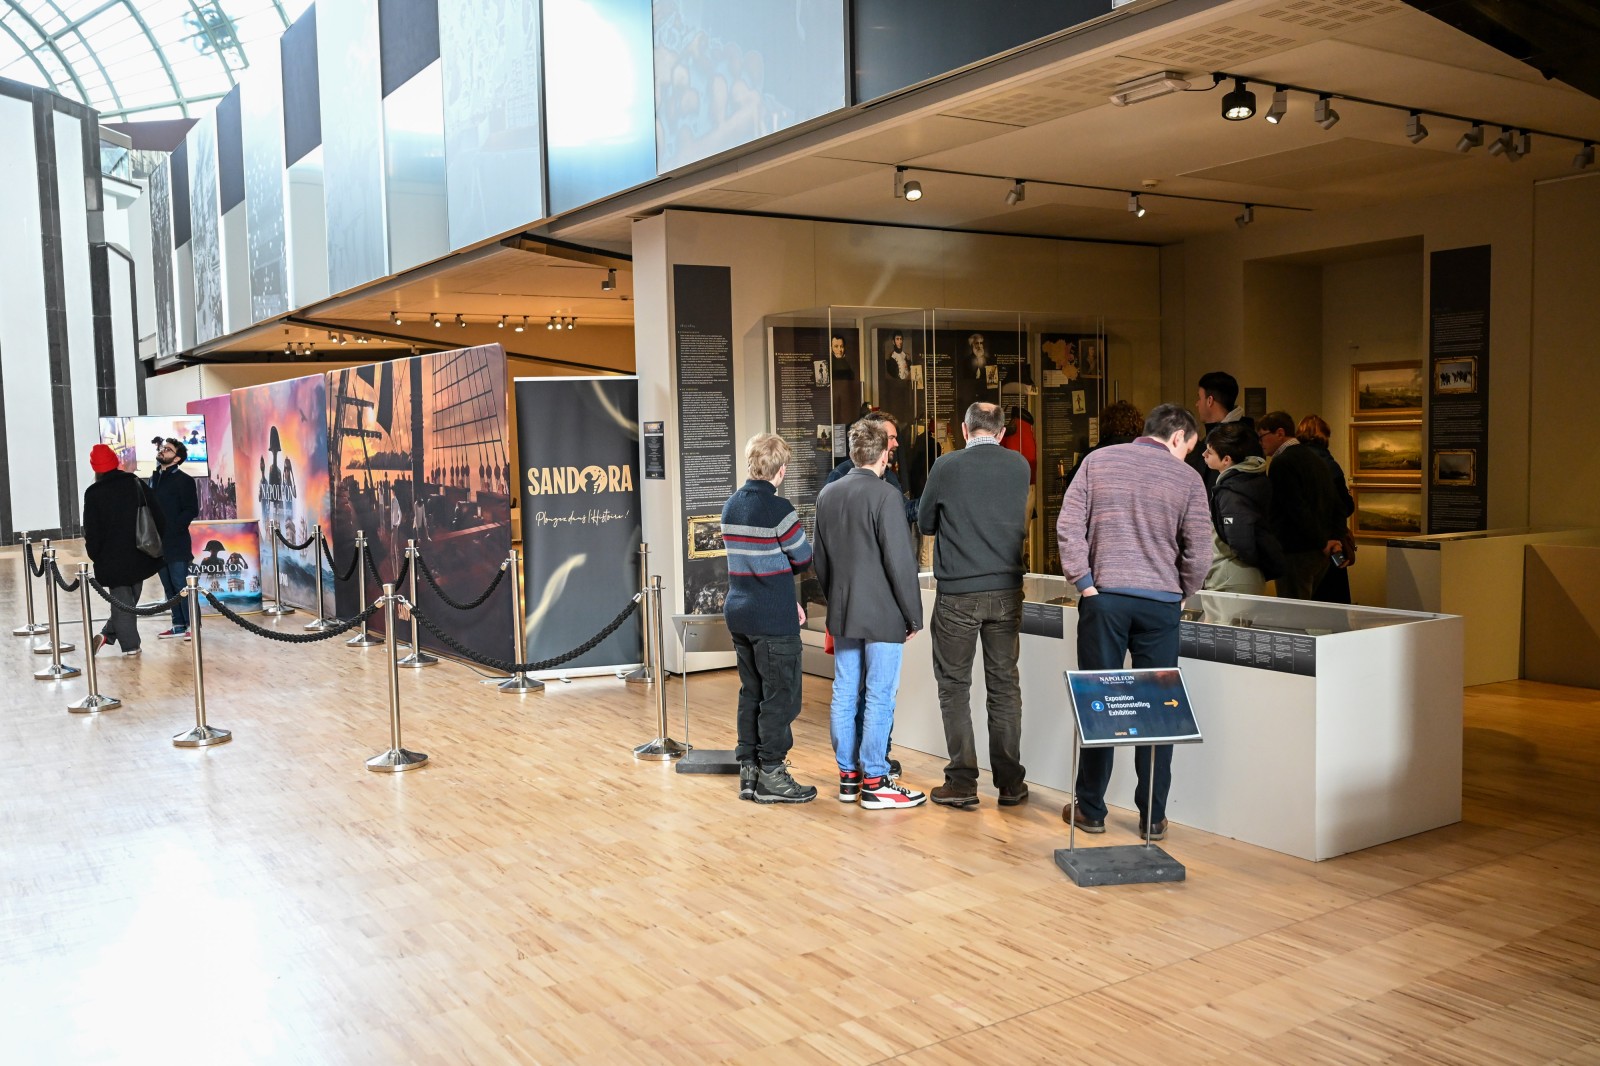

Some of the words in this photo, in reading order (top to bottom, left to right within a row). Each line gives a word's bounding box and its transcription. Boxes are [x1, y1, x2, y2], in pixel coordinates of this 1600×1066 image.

[527, 464, 633, 496] SANDORA
[535, 511, 567, 528] Plongez
[567, 510, 586, 525] dans
